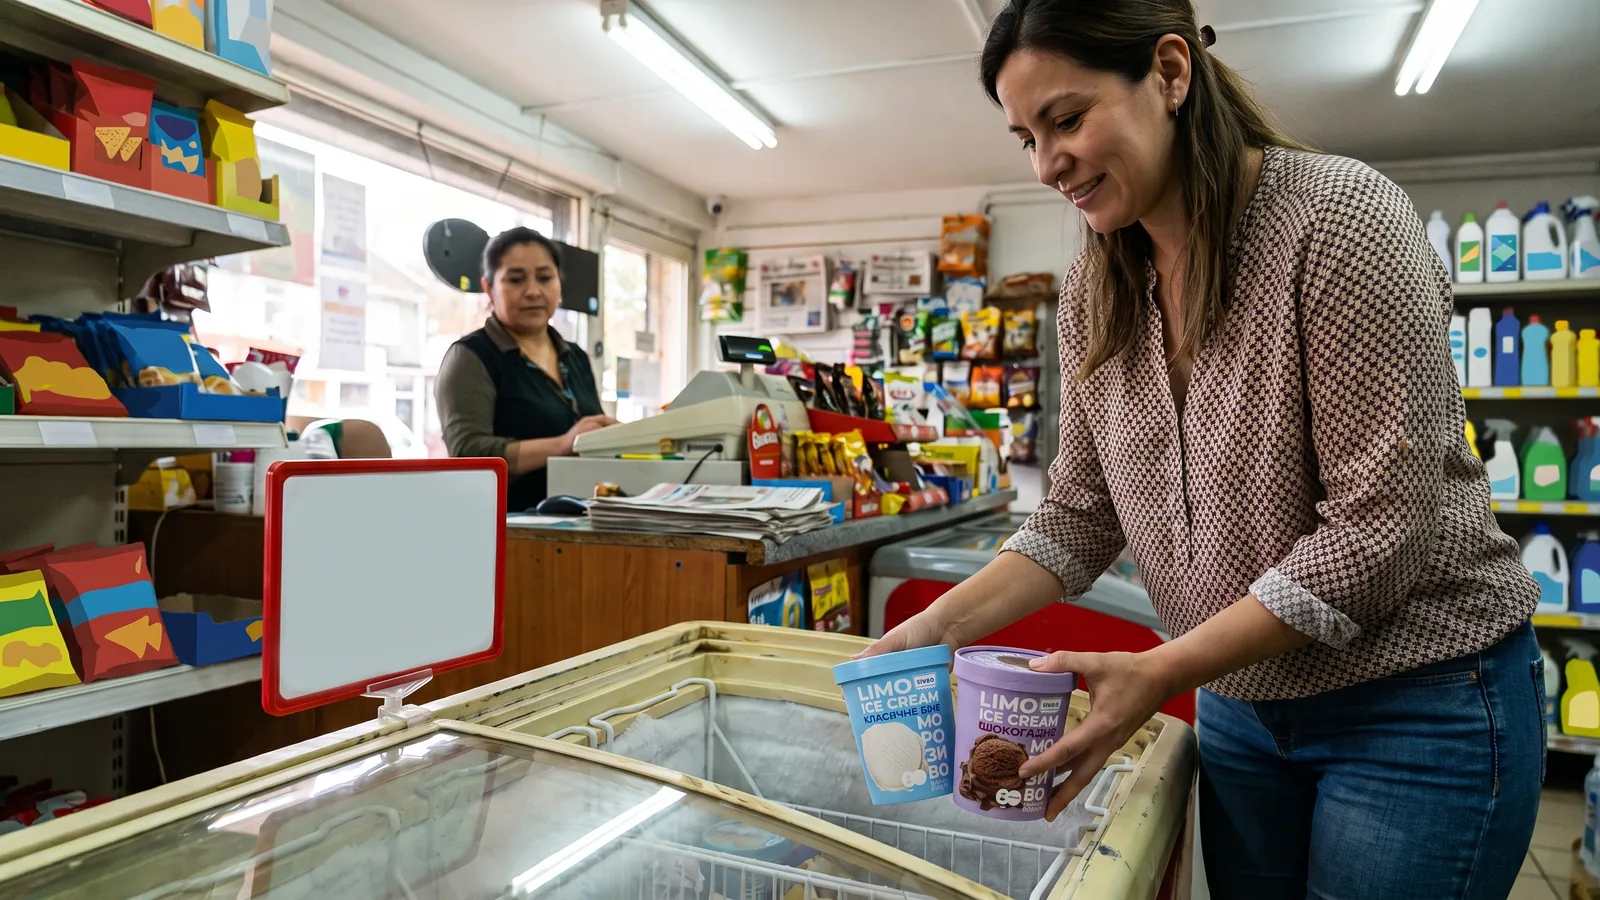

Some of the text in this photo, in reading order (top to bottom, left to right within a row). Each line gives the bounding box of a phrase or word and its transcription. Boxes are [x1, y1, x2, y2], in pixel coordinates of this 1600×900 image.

[857, 678, 912, 702] LIMO
[980, 690, 1038, 714] LIMO
[861, 691, 939, 715] ICE CREAM
[917, 713, 942, 729] МО
[979, 708, 1059, 728] ICE CREAM
